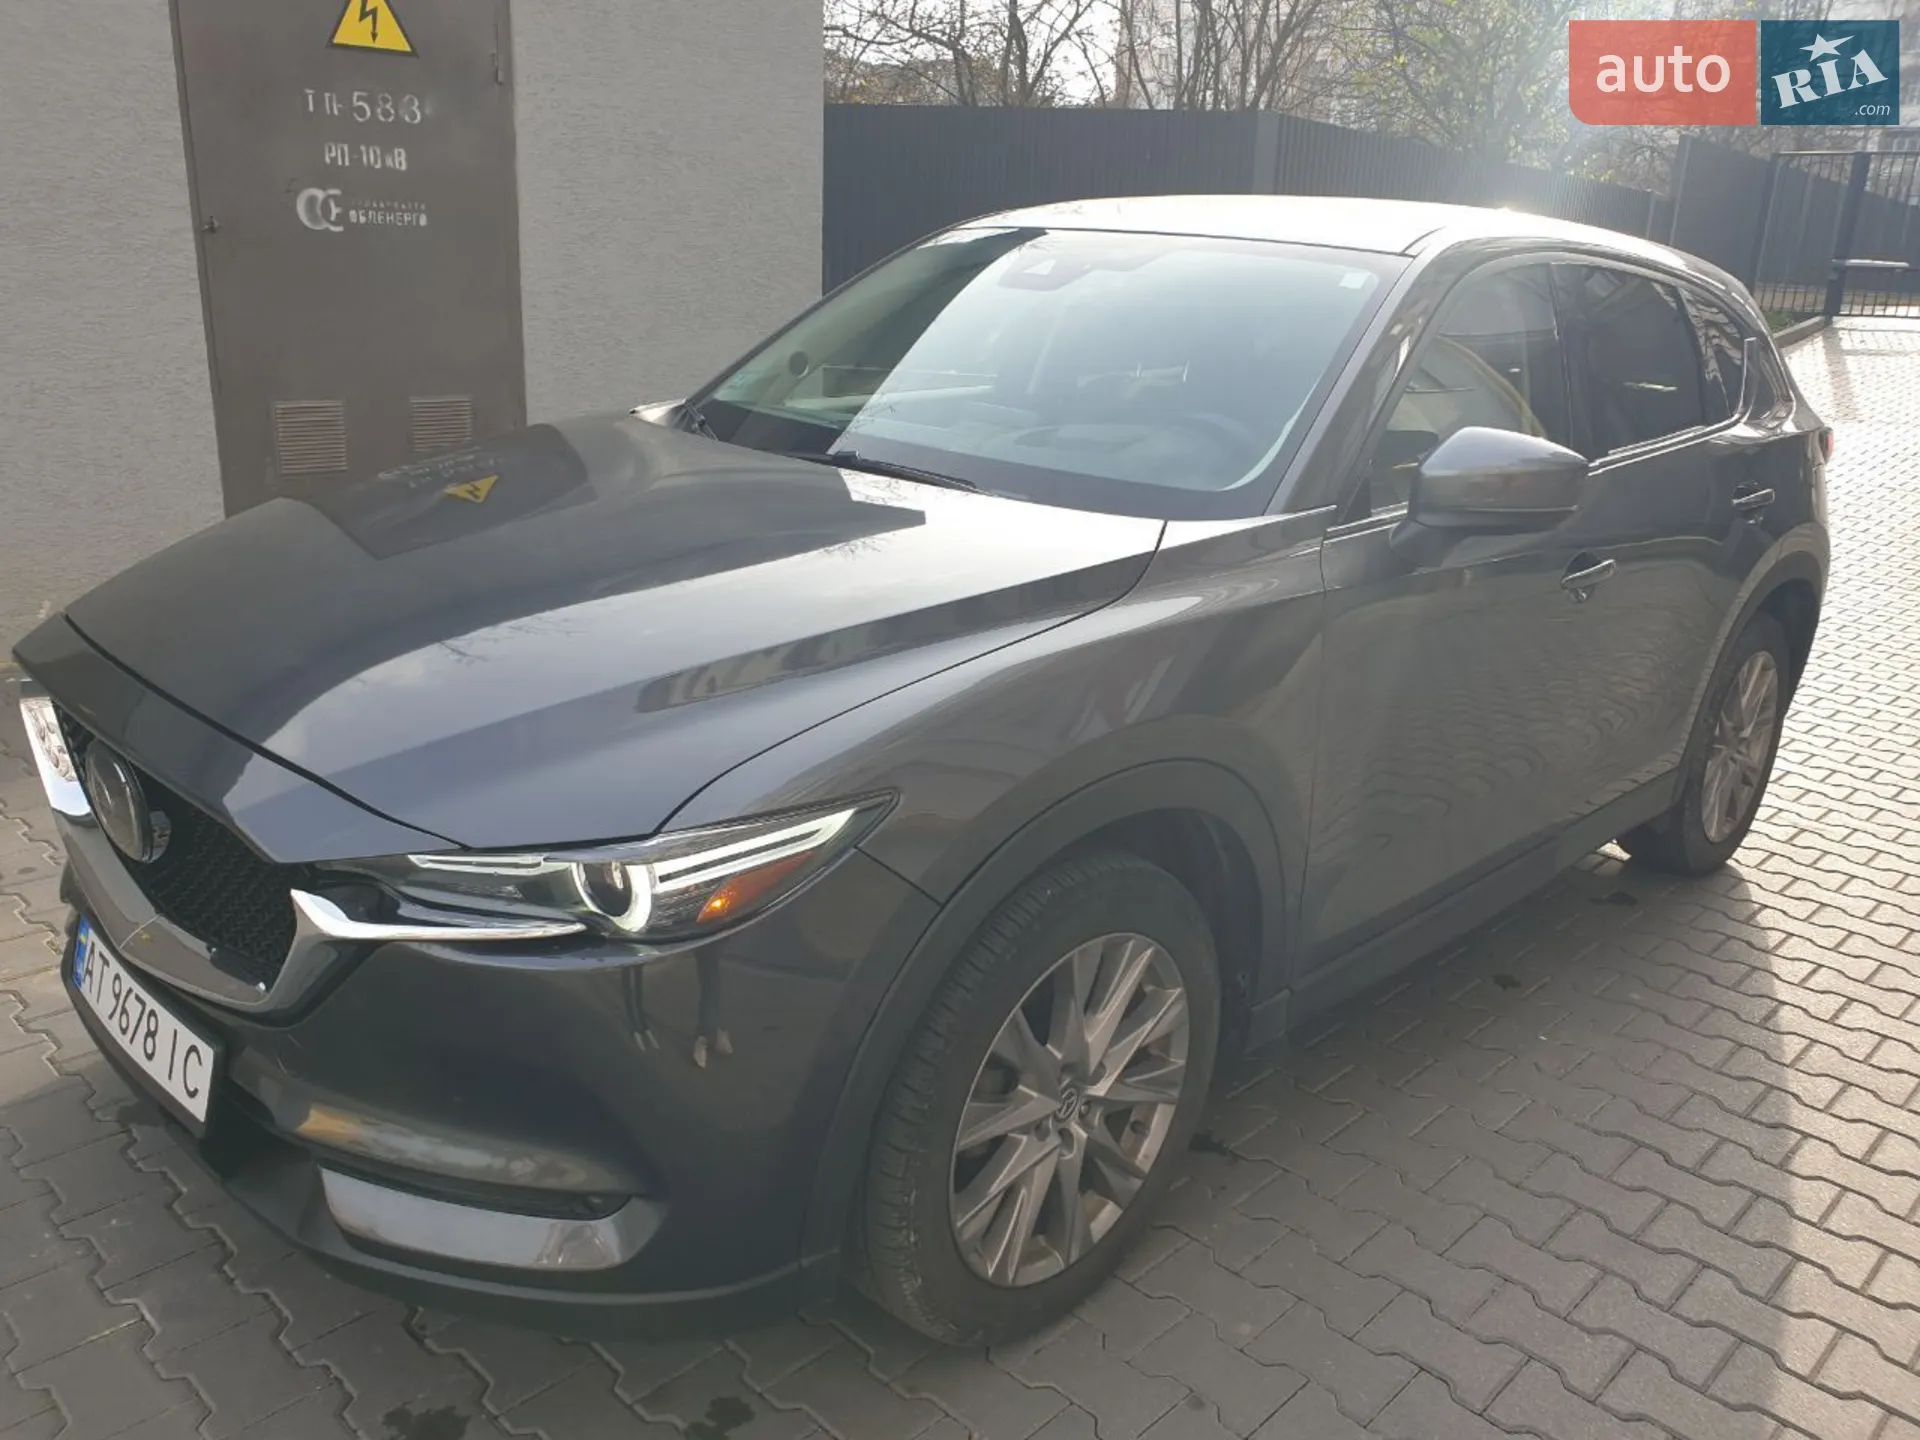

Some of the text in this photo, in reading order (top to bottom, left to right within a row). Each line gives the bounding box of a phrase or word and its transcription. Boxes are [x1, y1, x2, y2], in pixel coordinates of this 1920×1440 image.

[83, 942, 203, 1099] AT 9678 IC
